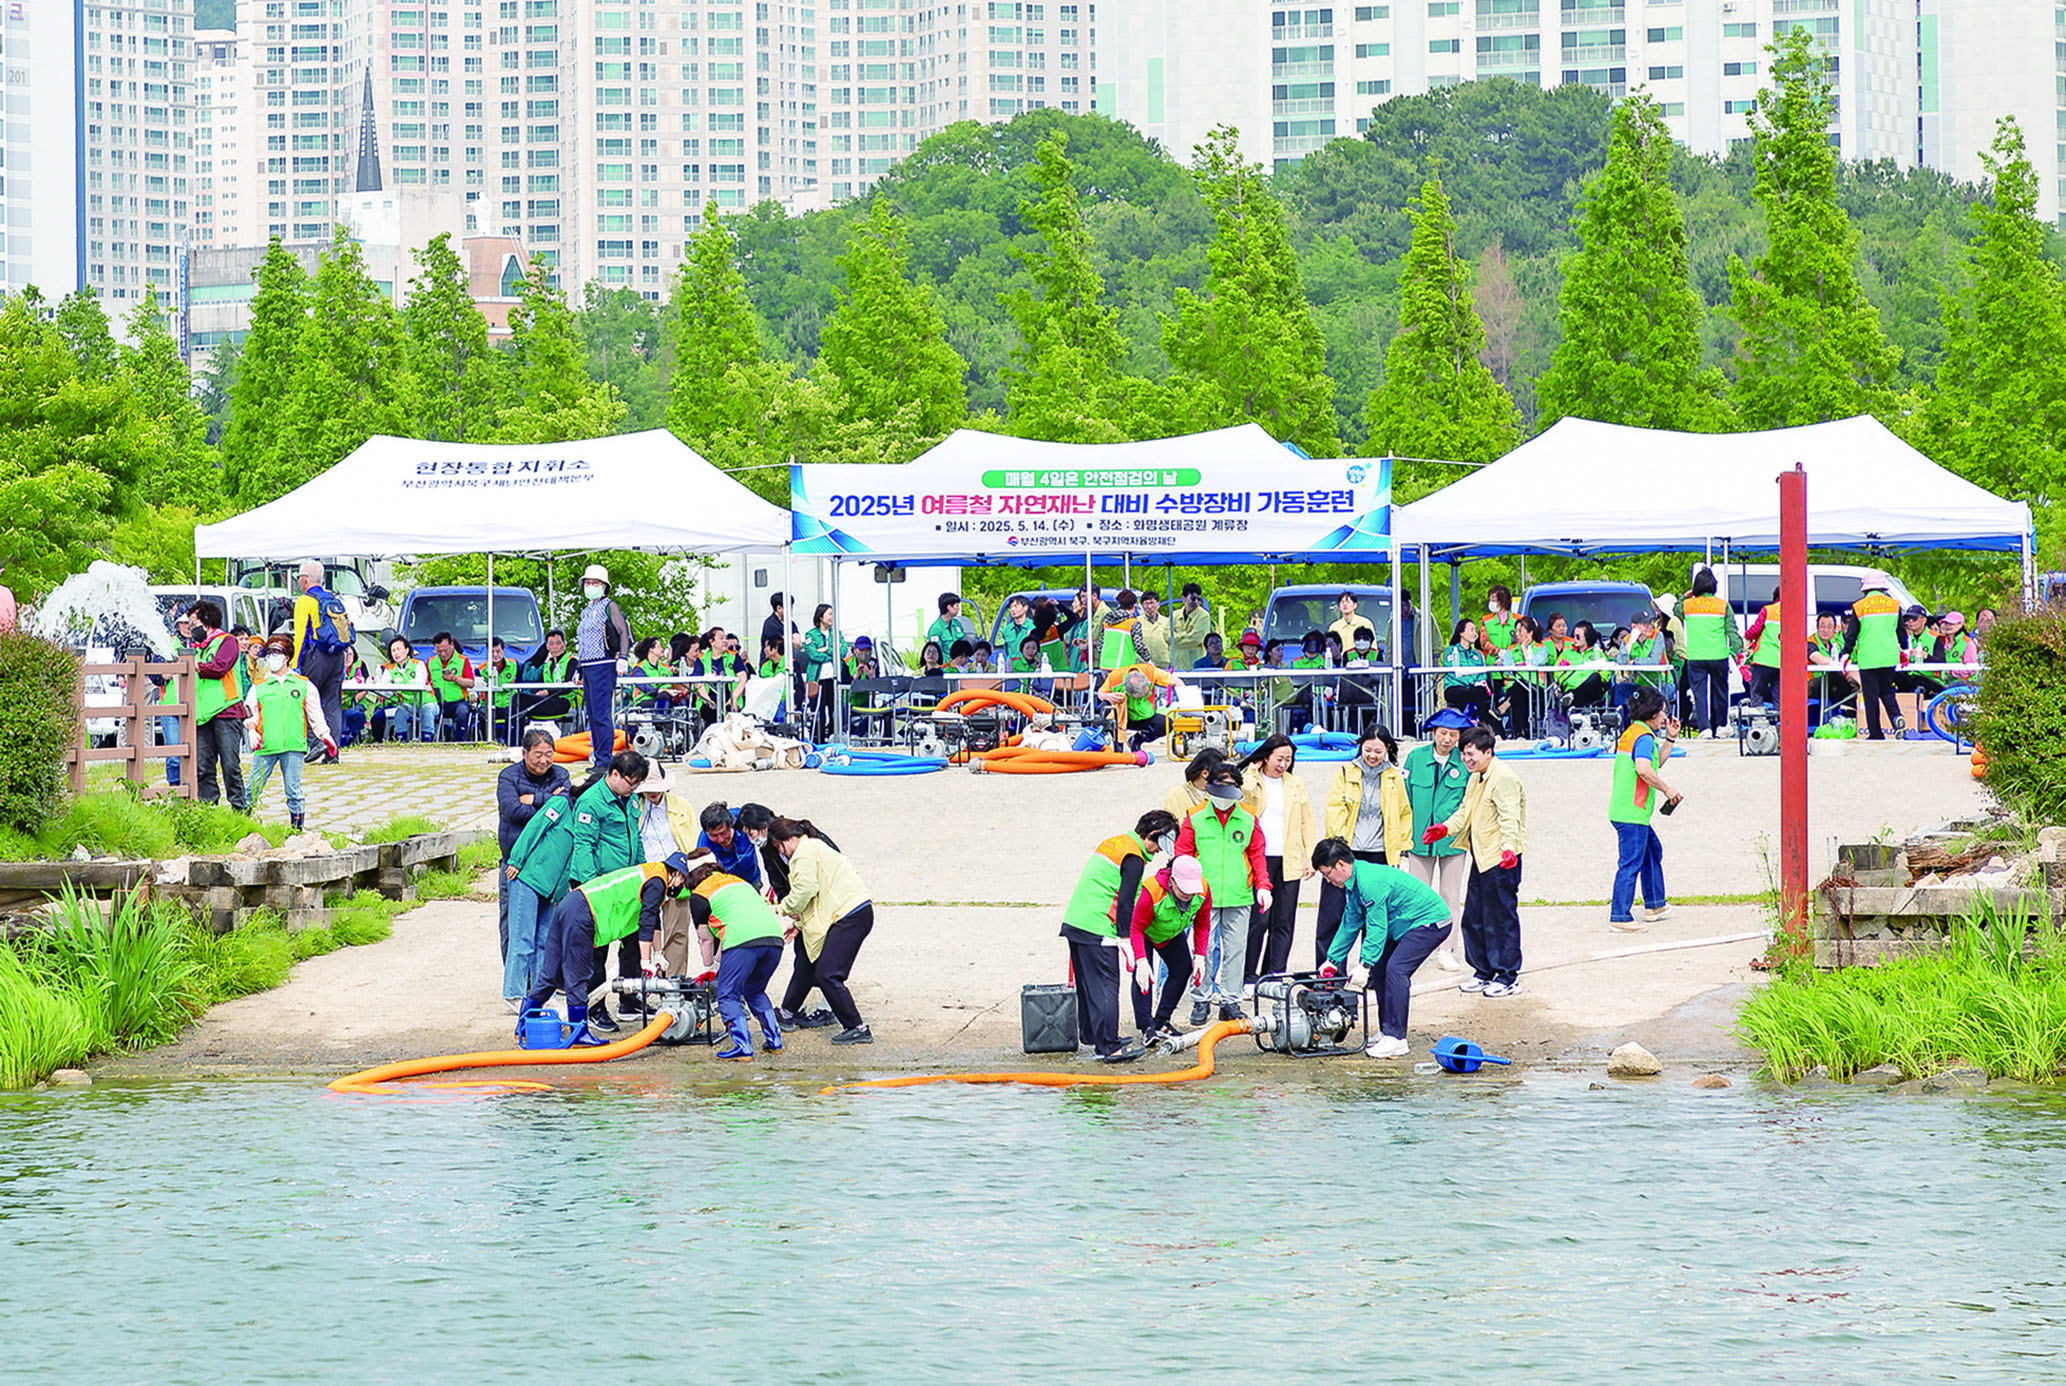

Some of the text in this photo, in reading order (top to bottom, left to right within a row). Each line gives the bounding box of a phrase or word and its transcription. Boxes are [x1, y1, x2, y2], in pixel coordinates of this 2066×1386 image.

[8, 70, 26, 84] 201
[1005, 470, 1178, 487] 매월 4일은 안전점검의 날
[829, 489, 1355, 517] 2025년 여름철 자연재난 대비 수방장비 가동훈련
[945, 520, 969, 533] 일시
[979, 520, 1014, 532] 2025.
[1017, 520, 1029, 532] 5.
[1032, 520, 1049, 532] 14.
[1052, 519, 1075, 532] (수)
[1099, 519, 1123, 531] 장소
[1133, 519, 1207, 532] 화명생태공원
[1211, 519, 1249, 531] 계류장
[1020, 536, 1067, 547] 부산광역시
